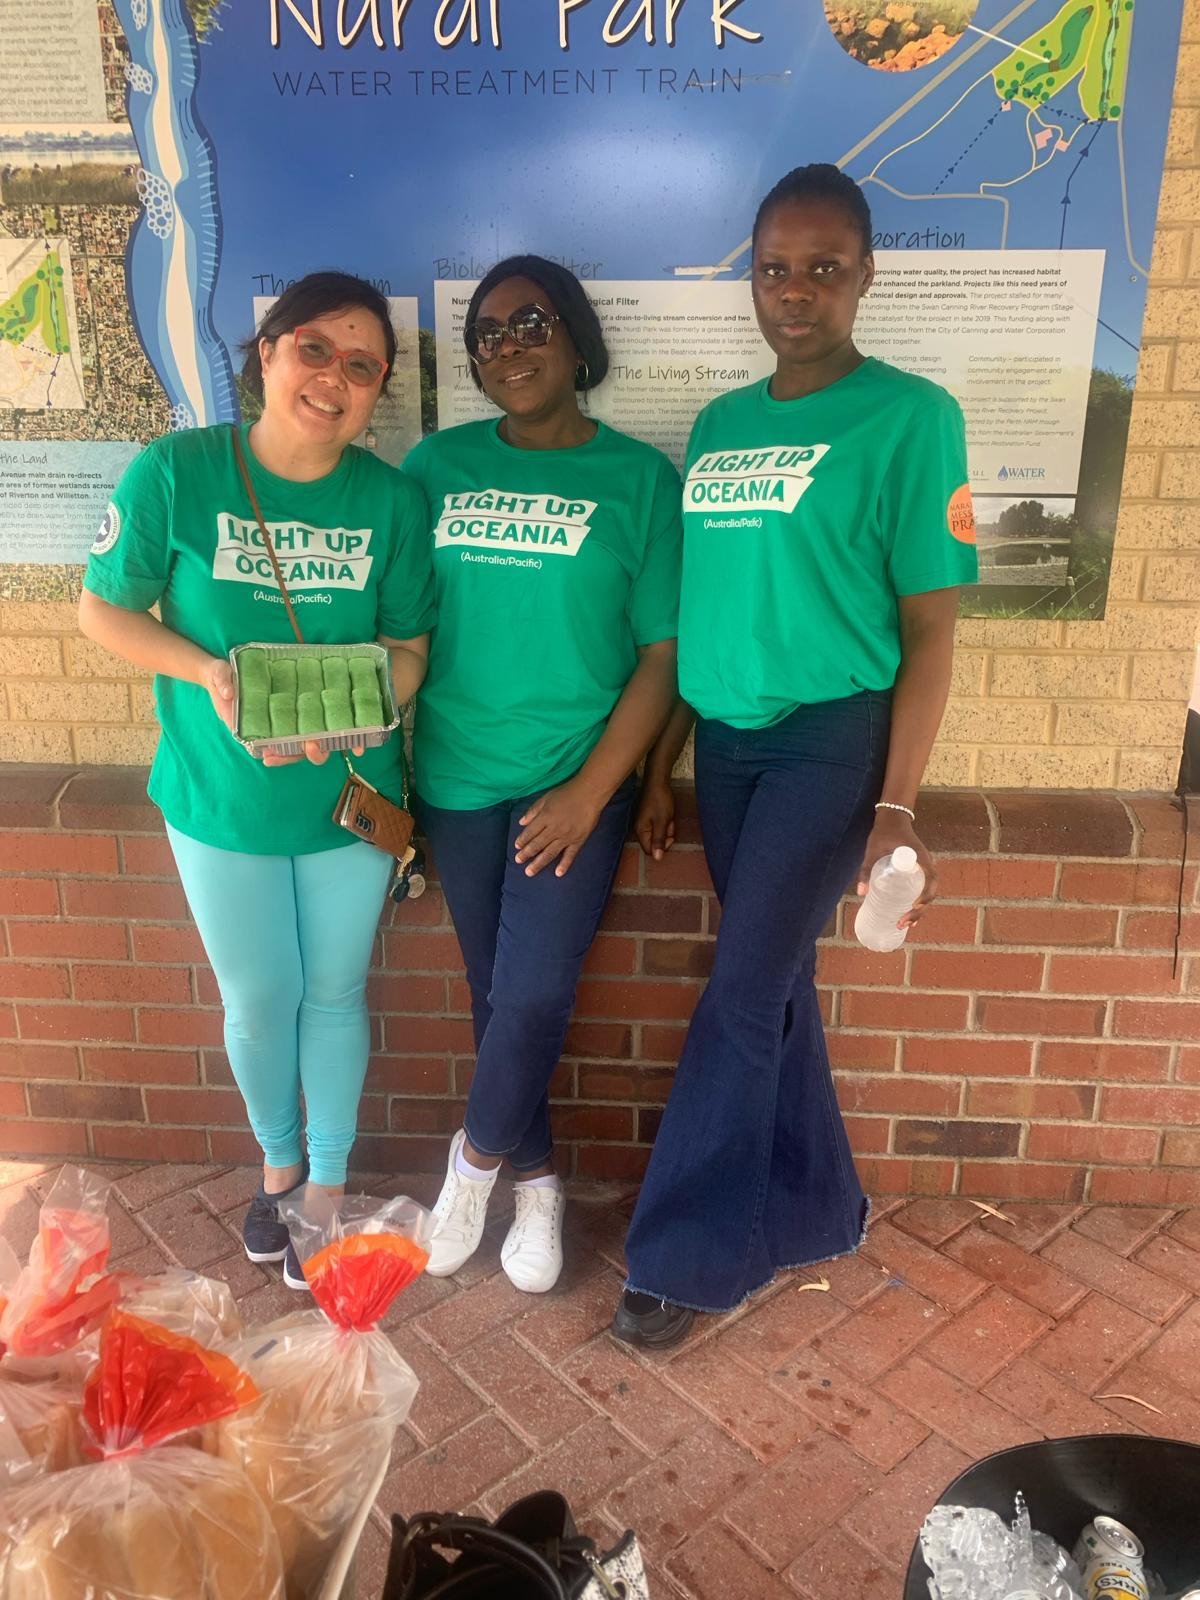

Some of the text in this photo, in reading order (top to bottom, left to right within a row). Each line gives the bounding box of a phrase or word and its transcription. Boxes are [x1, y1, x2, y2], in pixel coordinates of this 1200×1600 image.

[272, 67, 742, 96] WATER TREATMENT TRAIN
[616, 297, 640, 306] Filter
[613, 366, 749, 385] The Living Stream
[22, 451, 48, 464] Land
[697, 449, 815, 473] LIGHT UP
[1008, 468, 1045, 478] WATER
[691, 480, 785, 504] OCEANIA
[450, 493, 586, 518] LIGHT UP
[227, 519, 362, 554] LIGHT UP
[448, 520, 568, 546] OCEANIA
[236, 554, 355, 582] OCEANIA
[460, 552, 542, 570] (Australia/Pacific)
